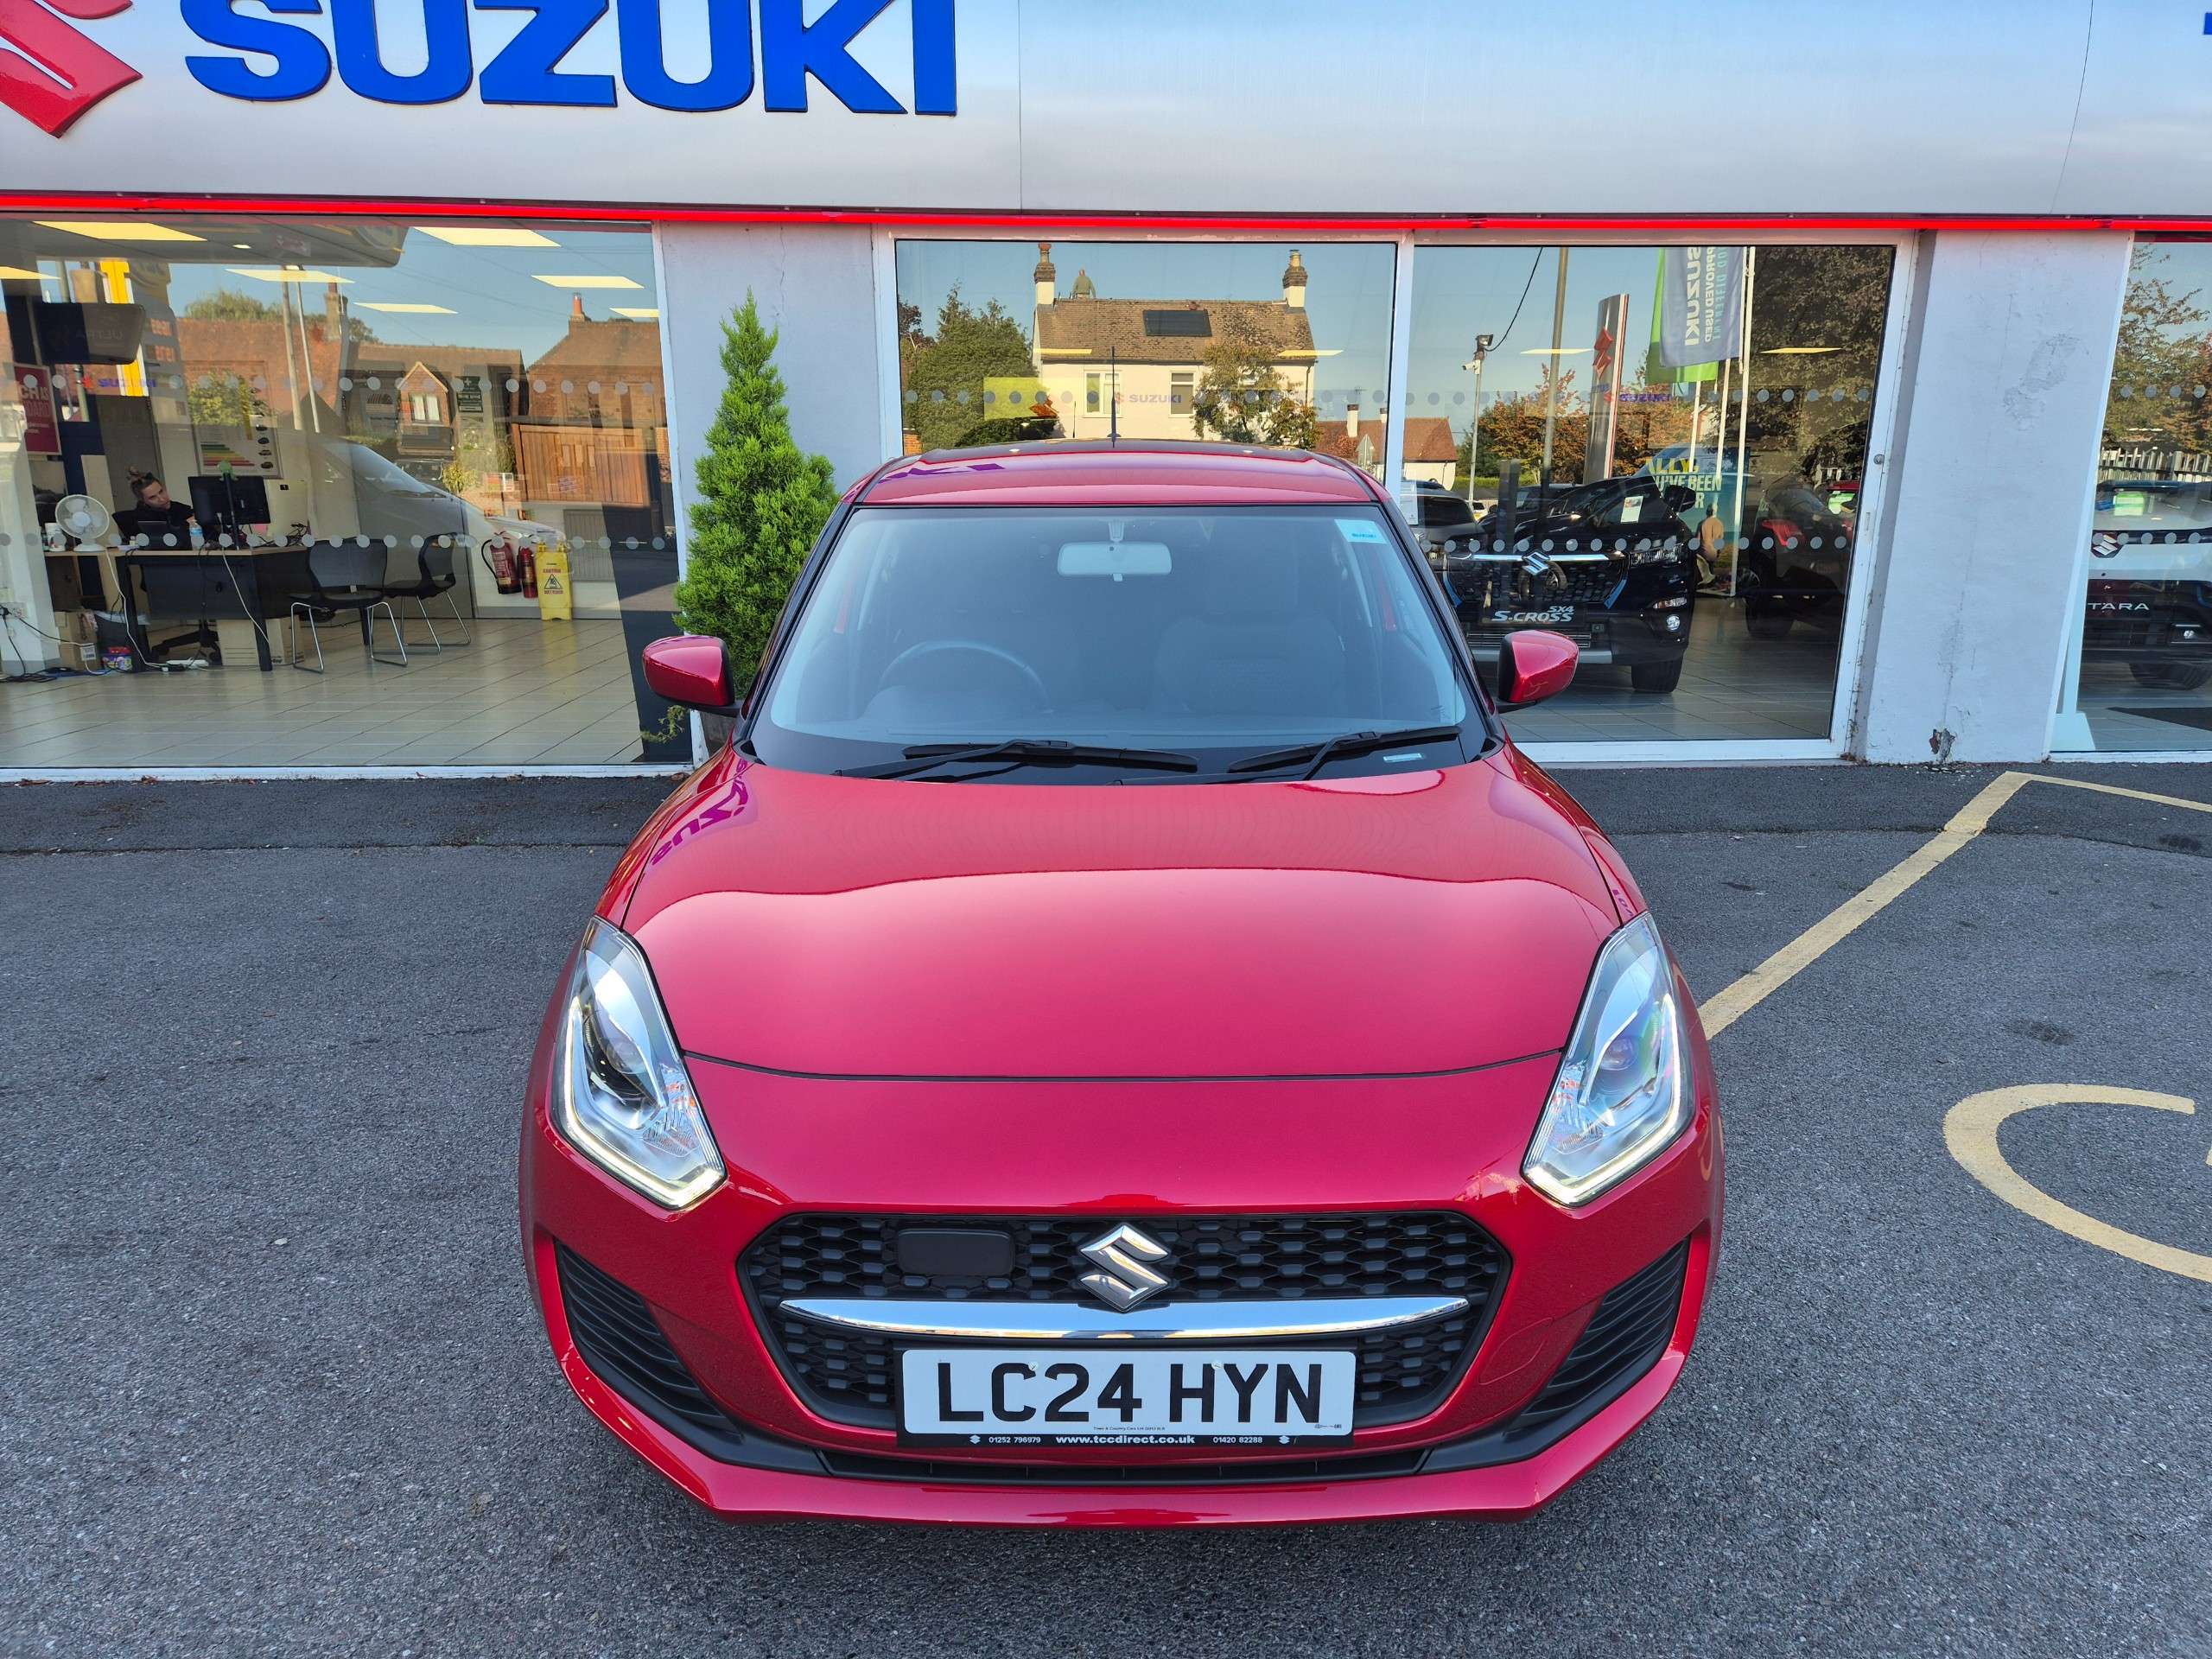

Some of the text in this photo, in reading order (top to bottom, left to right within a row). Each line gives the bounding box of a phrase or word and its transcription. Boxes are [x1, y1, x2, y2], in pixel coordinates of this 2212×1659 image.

[180, 0, 957, 117] SUZUKI
[1128, 394, 1182, 404] SUZUKI
[938, 1362, 1322, 1423] LC24 HYN
[1055, 1435, 1196, 1444] www.tccdirect.co.uk
